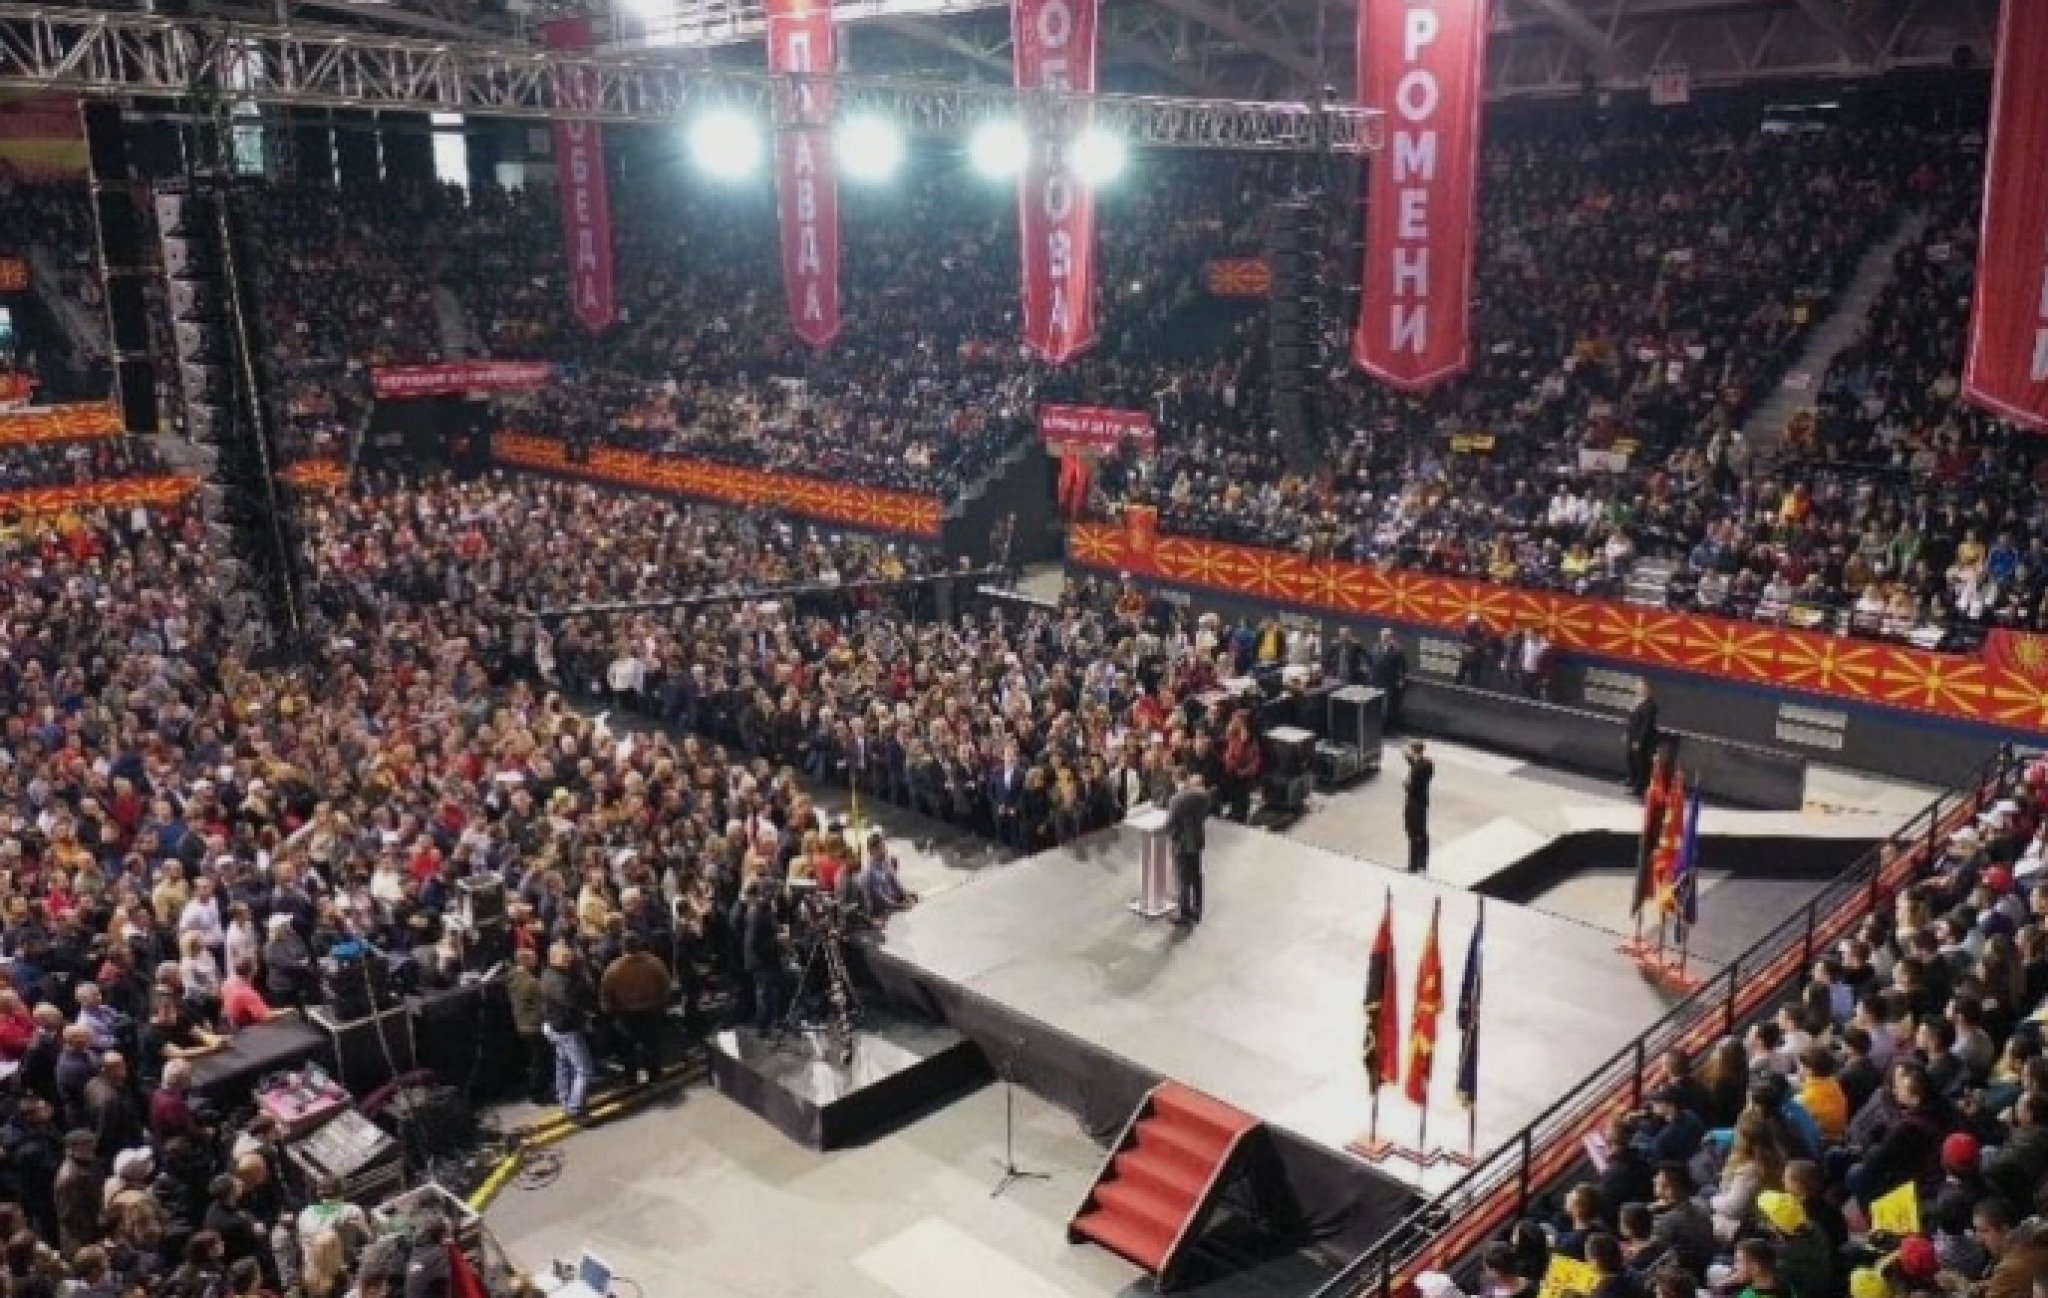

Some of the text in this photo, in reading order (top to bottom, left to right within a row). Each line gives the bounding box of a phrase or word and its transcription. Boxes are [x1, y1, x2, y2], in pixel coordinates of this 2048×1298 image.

[566, 68, 598, 307] ОБЕДА
[1036, 2, 1072, 337] ОБОВА
[1391, 8, 1439, 353] РОМЕНИ
